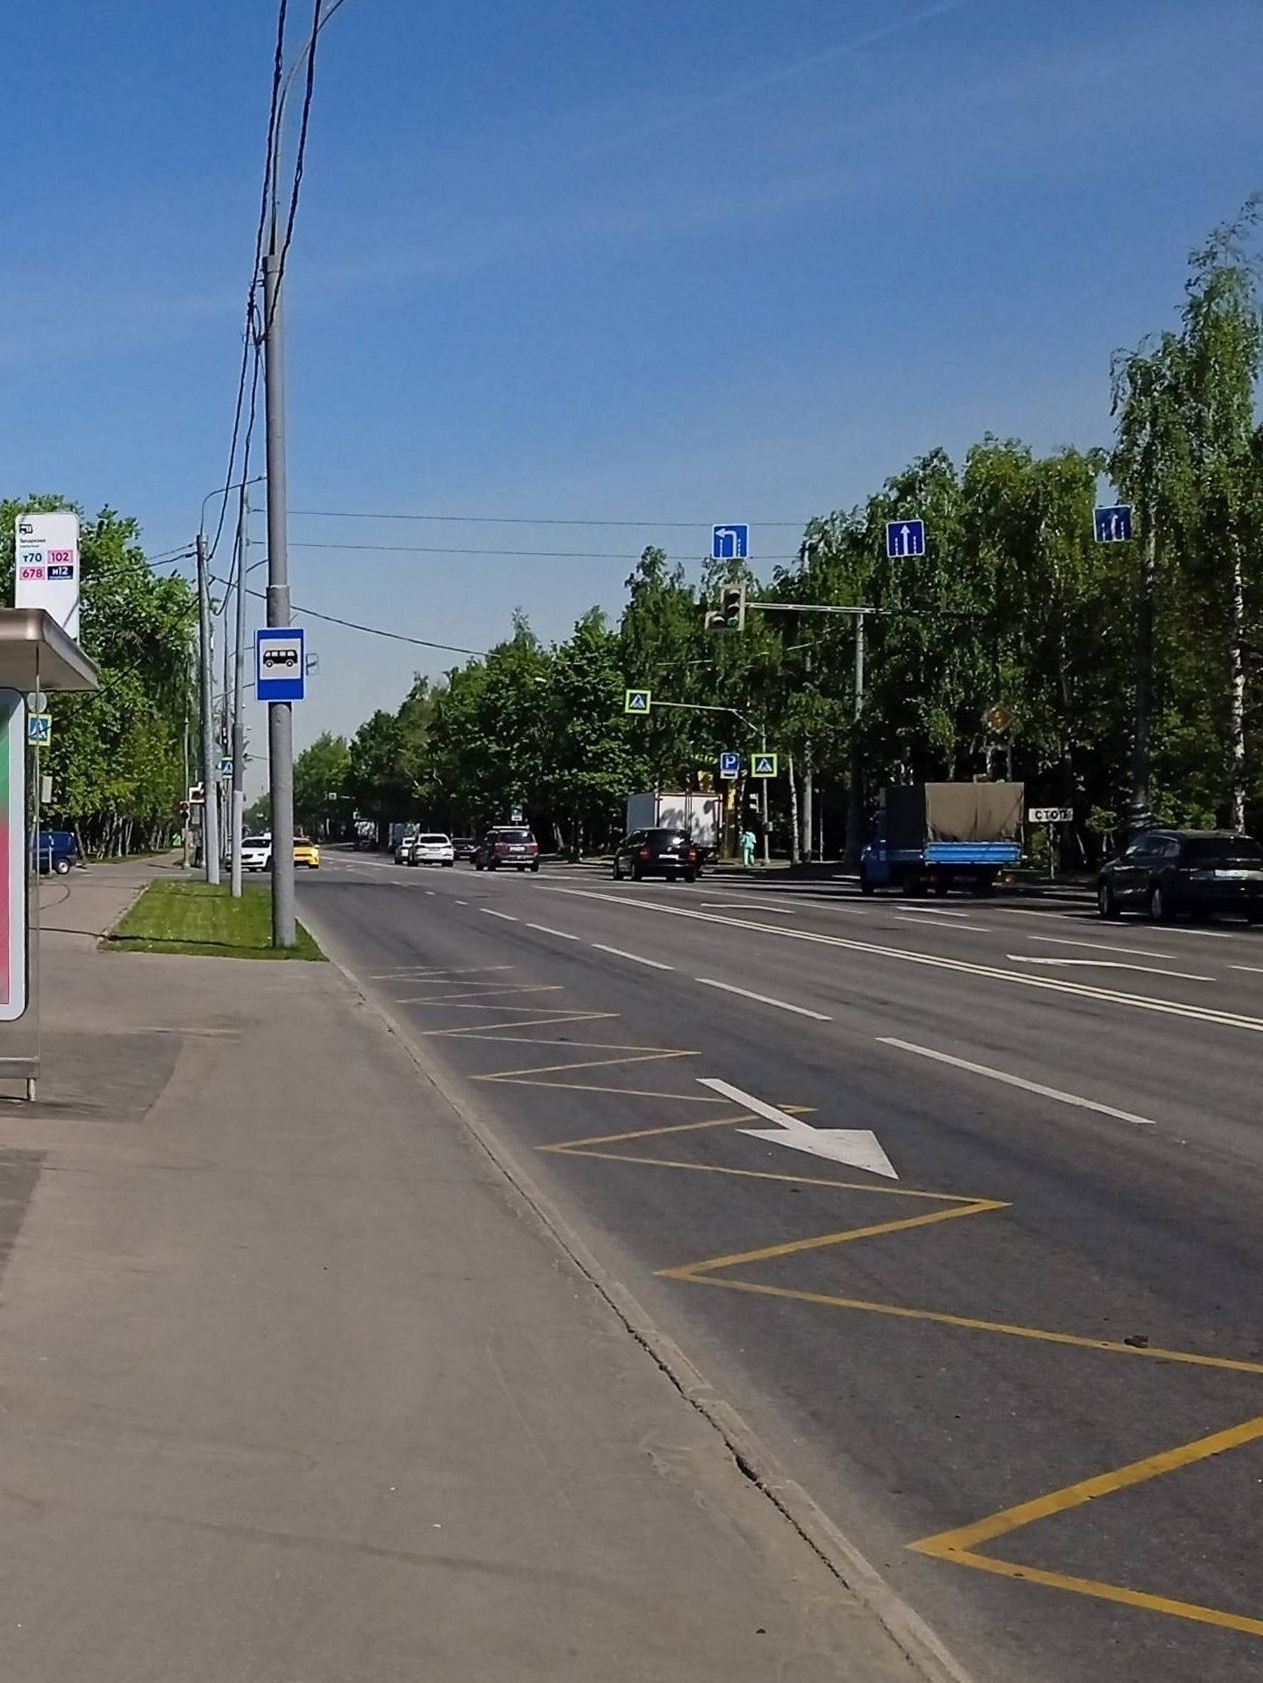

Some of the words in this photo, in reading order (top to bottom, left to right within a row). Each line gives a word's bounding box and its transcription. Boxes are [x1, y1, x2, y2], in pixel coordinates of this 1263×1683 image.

[51, 552, 69, 562] 102
[22, 569, 43, 578] 678
[1035, 810, 1067, 820] СТОП
